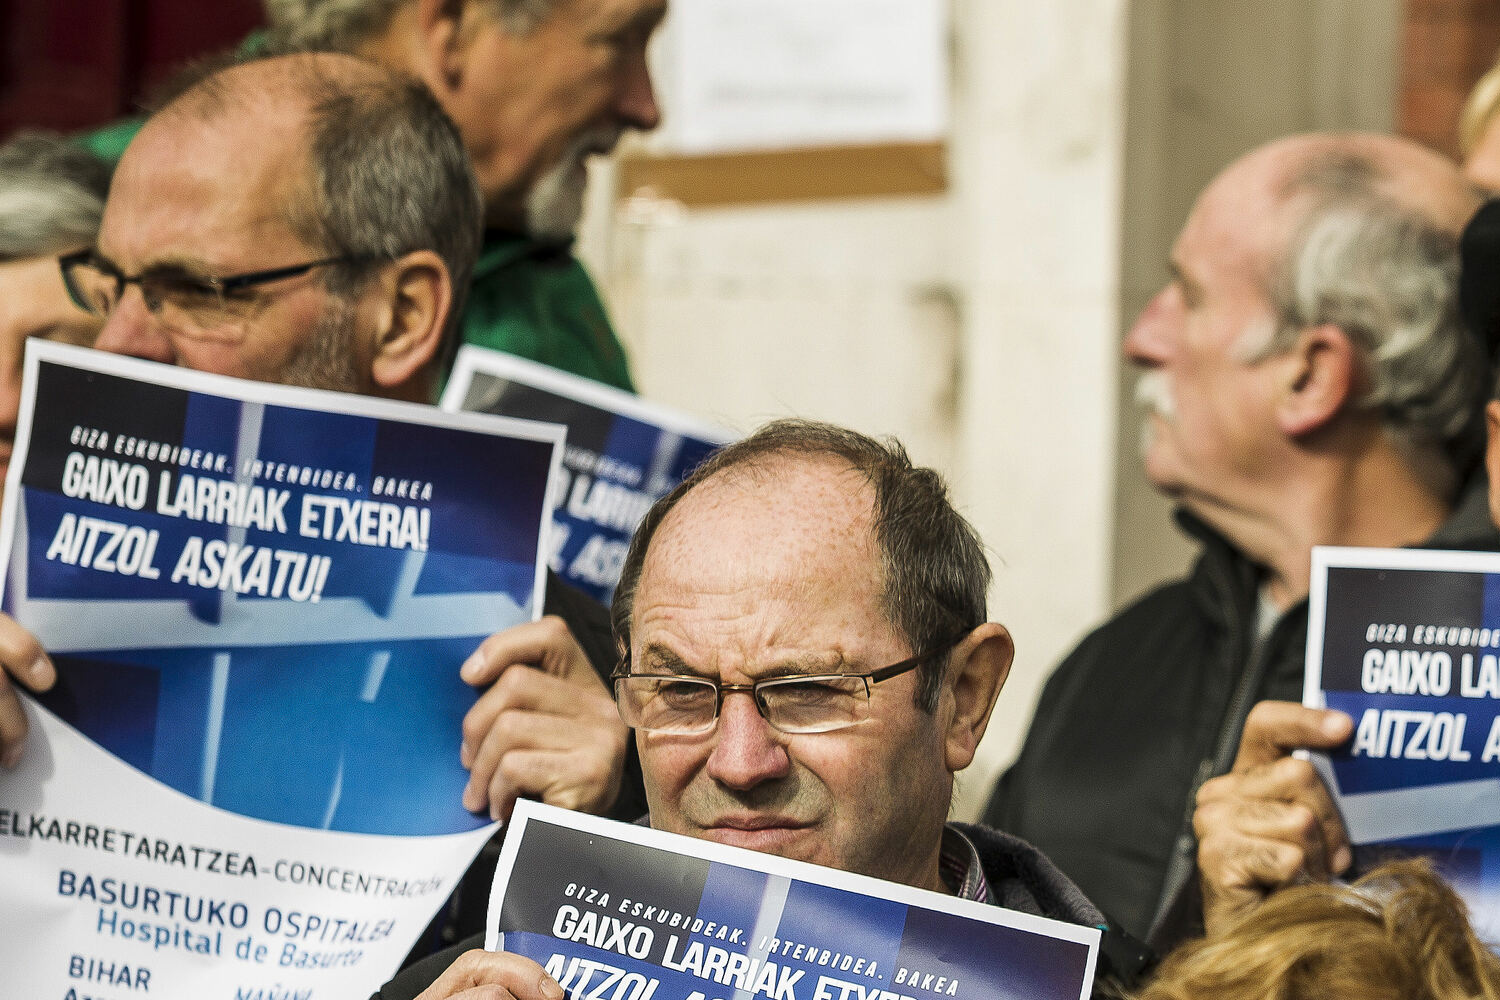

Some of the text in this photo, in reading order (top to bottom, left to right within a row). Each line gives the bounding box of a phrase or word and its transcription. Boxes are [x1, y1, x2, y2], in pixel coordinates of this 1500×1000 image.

[62, 450, 431, 552] GAIXO LARRIAK ETXERA!
[47, 512, 332, 603] AITZOL ASKATU!
[1361, 648, 1452, 697] GAIXO
[1351, 708, 1471, 762] AITZOL
[58, 869, 397, 946] BASURTUKO OSPITALEA
[552, 904, 654, 961] GAIXO
[97, 909, 363, 970] Hospital de Basurto
[564, 882, 960, 997] GIZA ESKUBIDEAK. IRTENBIDEA. BAKEA
[68, 954, 152, 992] BIHAR
